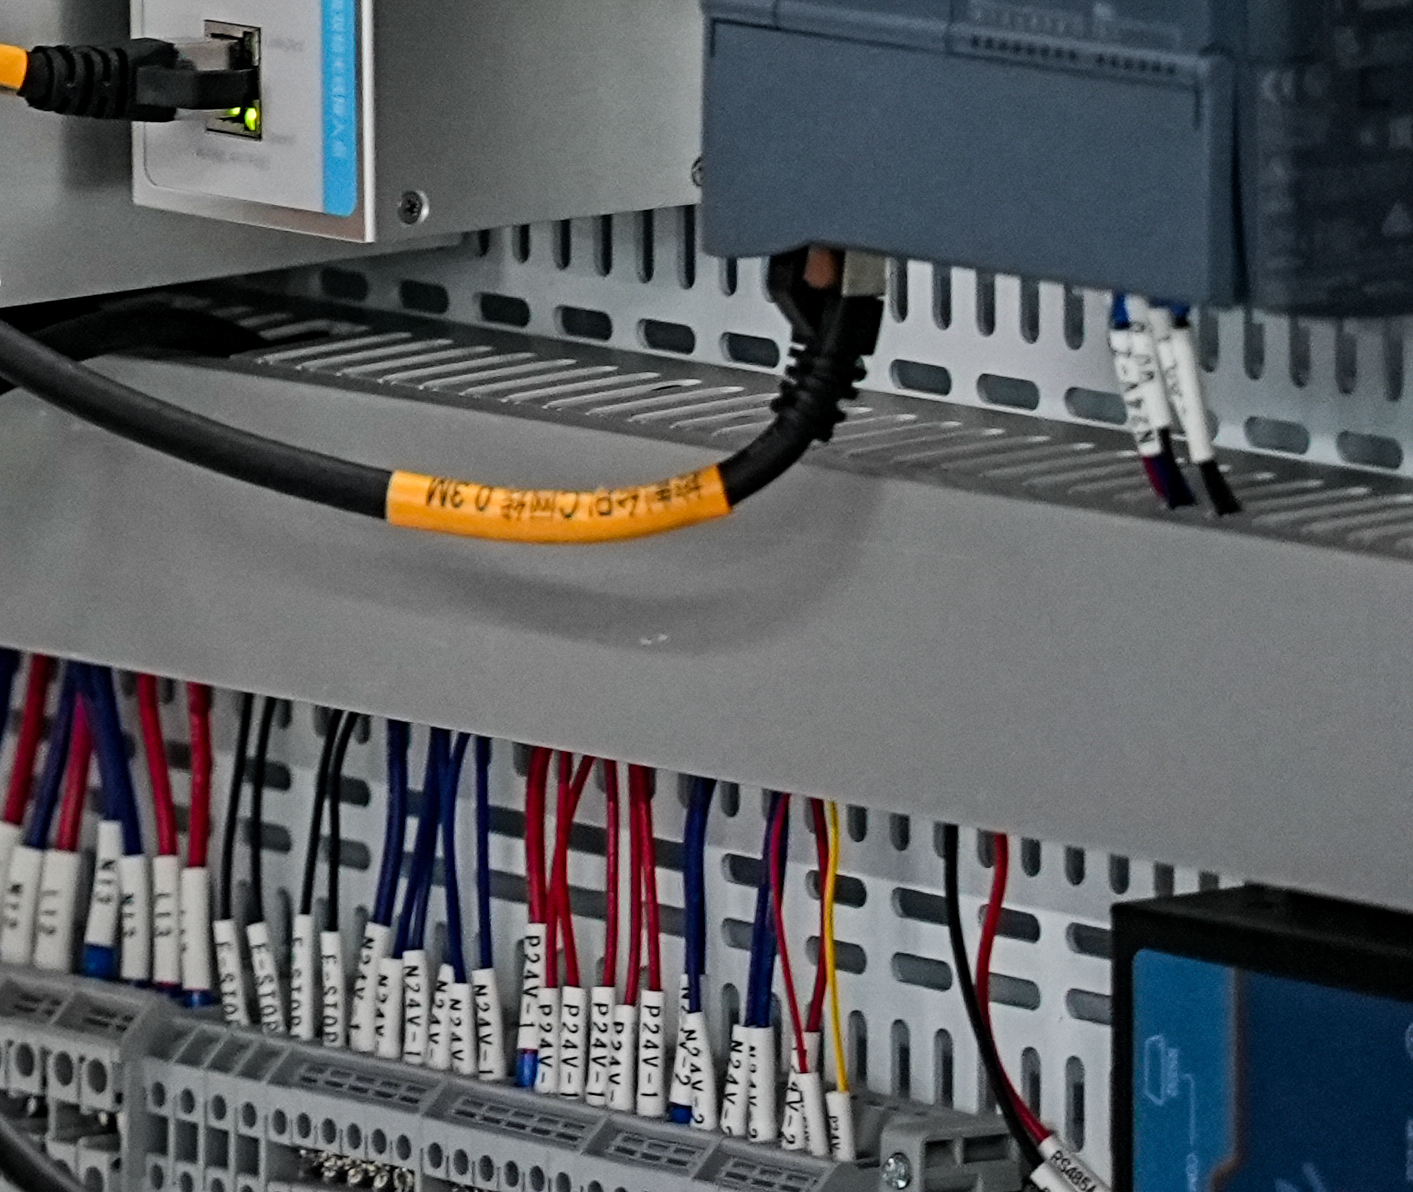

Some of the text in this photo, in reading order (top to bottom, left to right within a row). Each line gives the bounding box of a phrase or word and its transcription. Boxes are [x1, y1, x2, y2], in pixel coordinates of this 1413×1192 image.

[403, 965, 422, 1056] N24V-1
[517, 934, 541, 1029] P24V-1
[474, 984, 494, 1075] N24V-1
[561, 1003, 581, 1098] P24V-1
[587, 1002, 610, 1098] P24V-1
[641, 1004, 661, 1098] P24V-1
